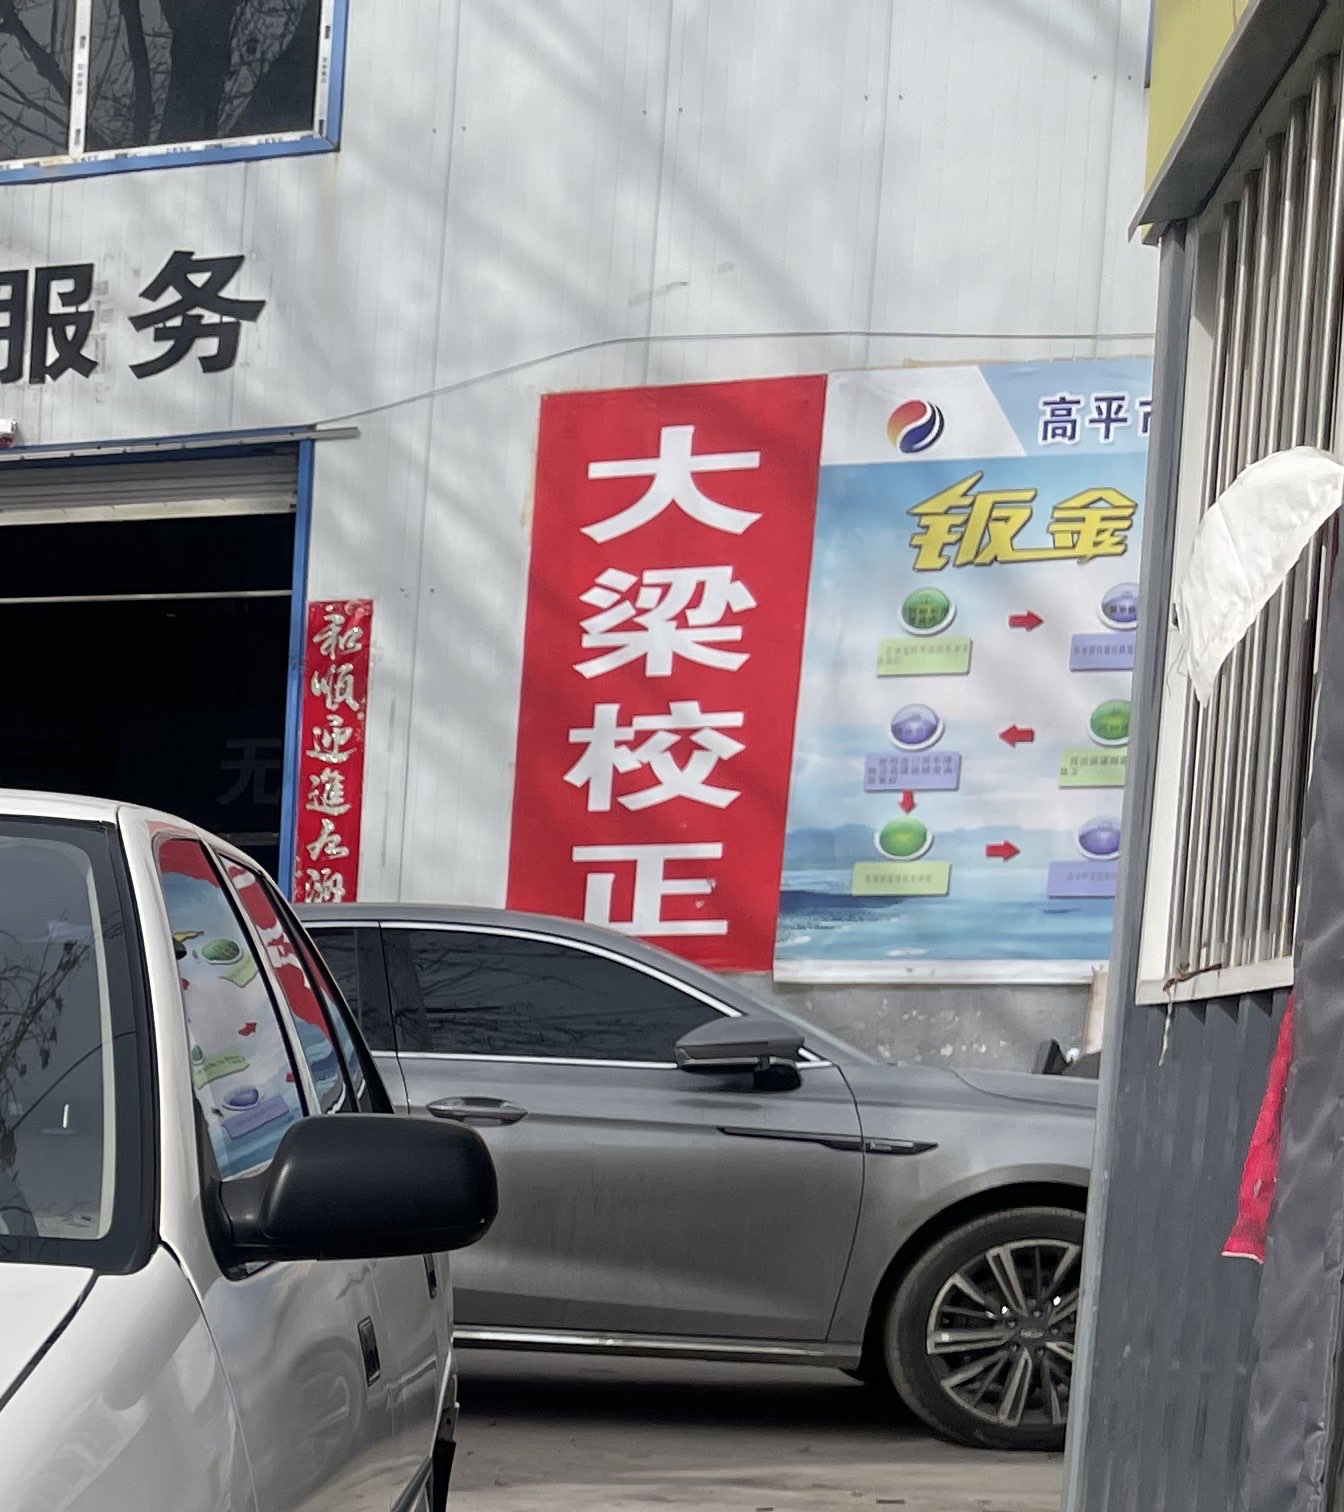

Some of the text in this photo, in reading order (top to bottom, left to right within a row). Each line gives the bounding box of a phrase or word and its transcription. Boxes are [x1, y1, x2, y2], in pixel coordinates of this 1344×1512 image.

[907, 470, 1138, 572] 钣金
[563, 424, 762, 937] 大梁校正
